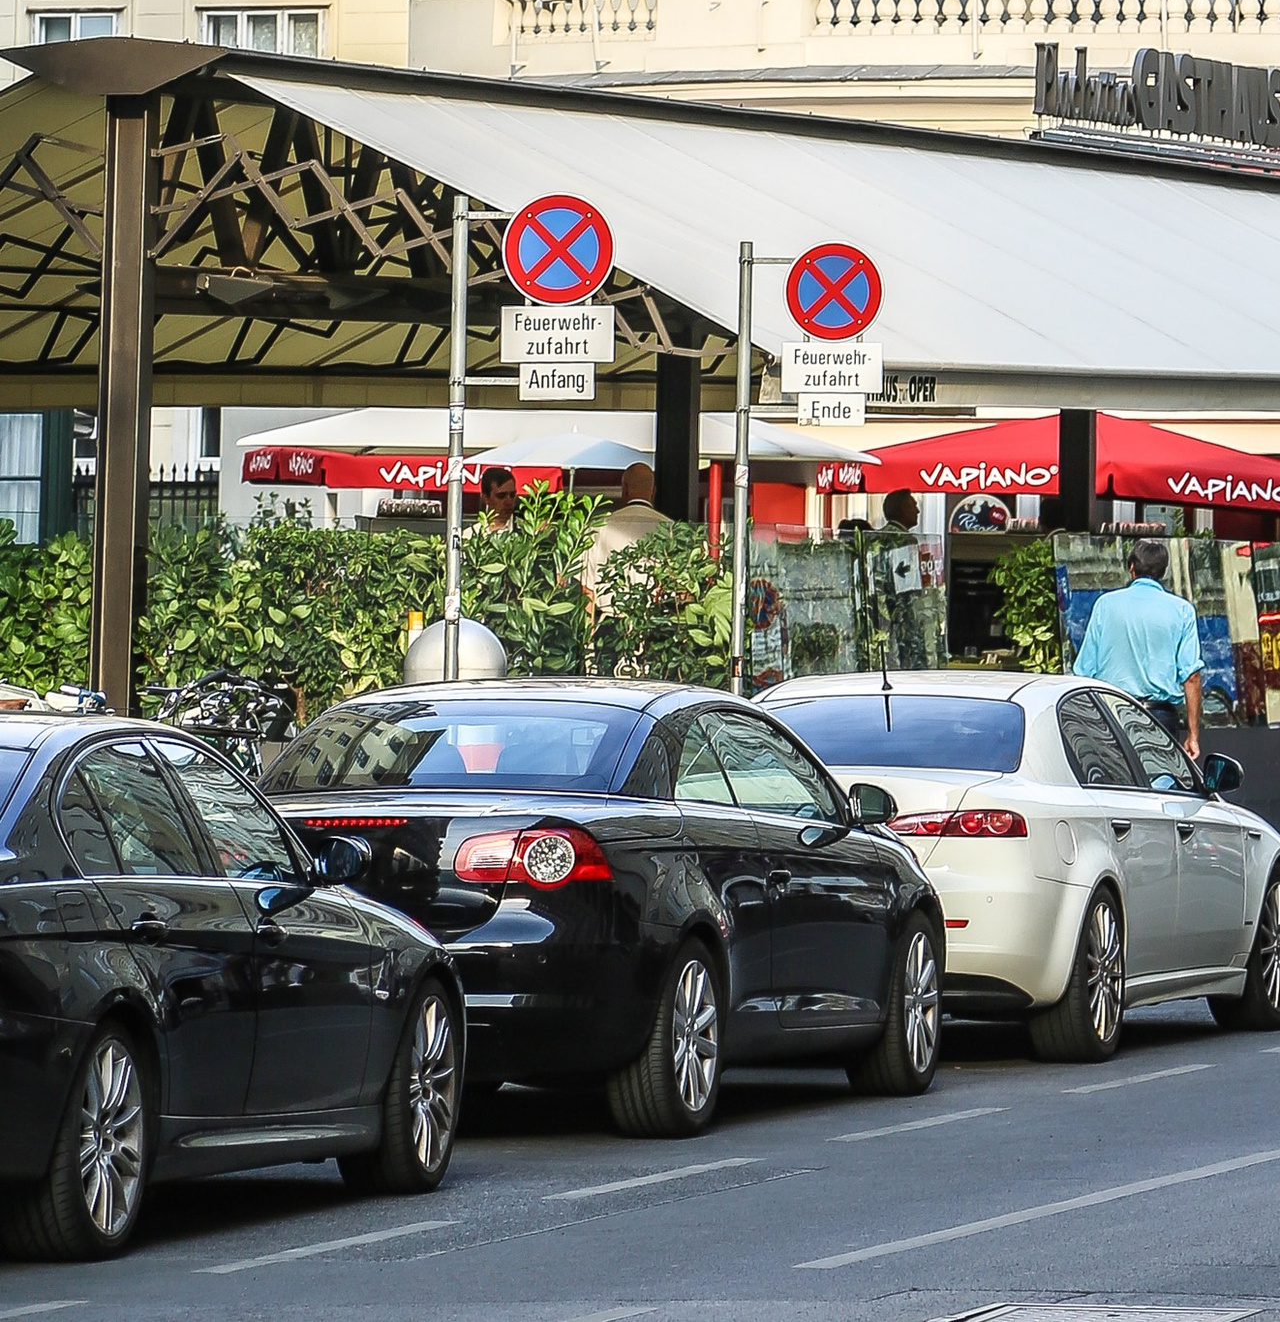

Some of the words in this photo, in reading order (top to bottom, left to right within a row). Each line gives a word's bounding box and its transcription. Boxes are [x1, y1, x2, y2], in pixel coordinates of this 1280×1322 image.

[514, 313, 602, 331] Feuerwehr-
[526, 337, 589, 355] zufahrt
[794, 349, 872, 365] Feuerwehr-
[528, 369, 585, 393] Anfang
[804, 370, 860, 387] zufahrt
[909, 375, 937, 402] OPER
[811, 401, 852, 419] Ende
